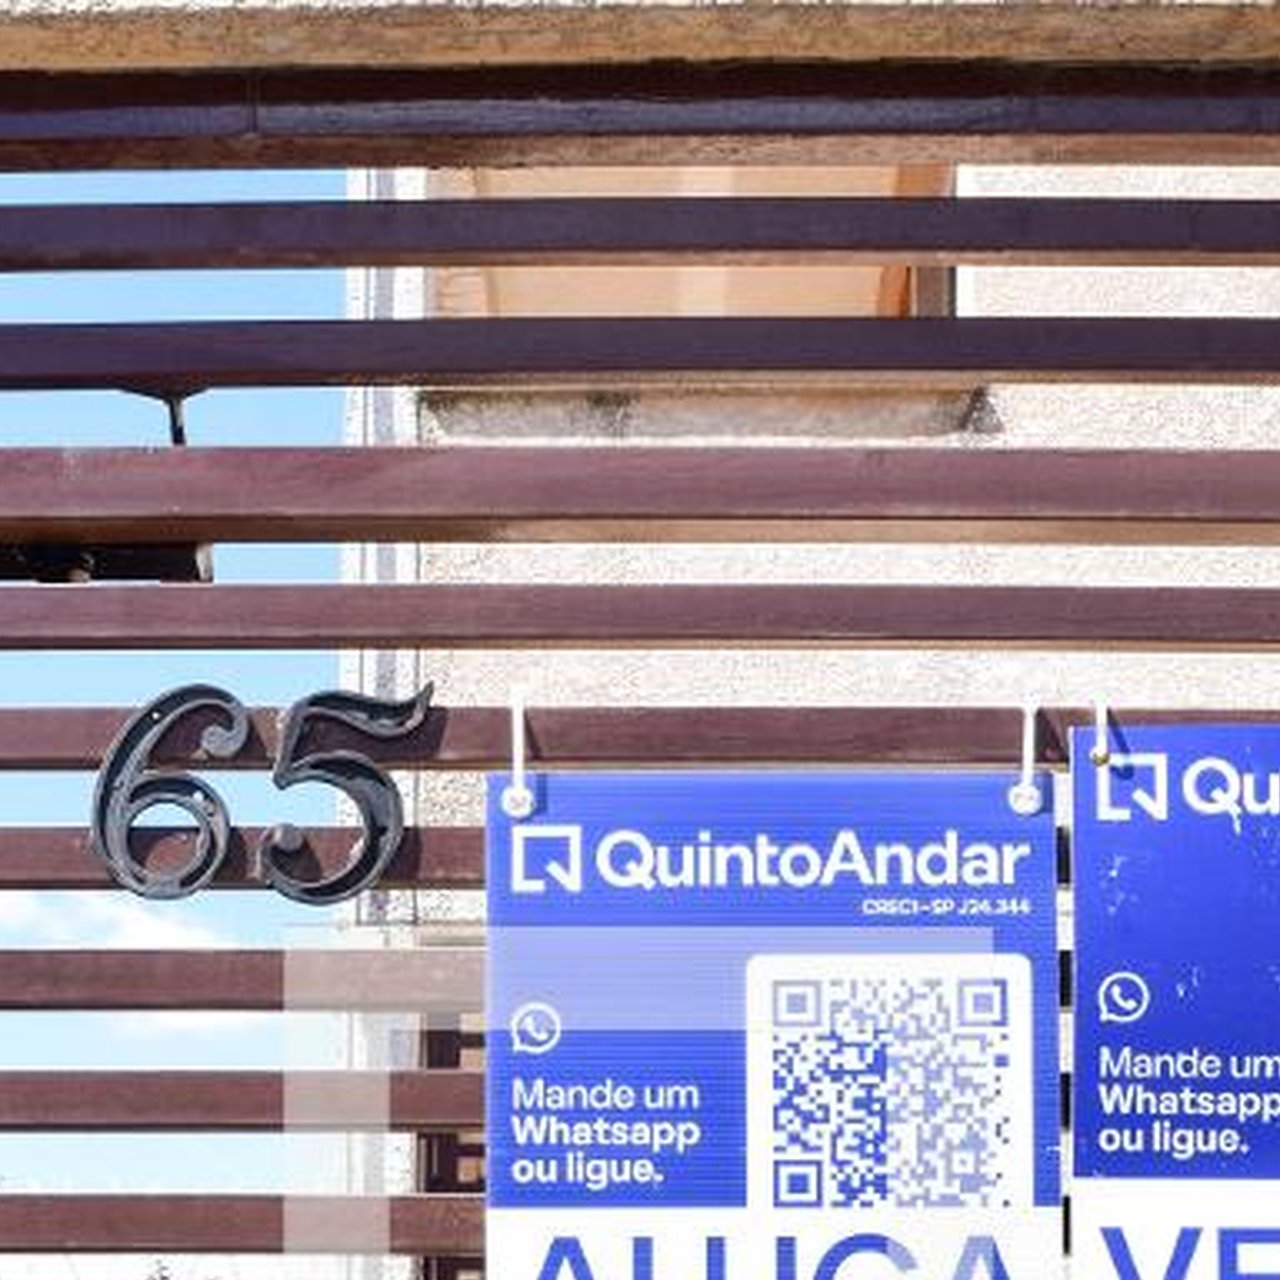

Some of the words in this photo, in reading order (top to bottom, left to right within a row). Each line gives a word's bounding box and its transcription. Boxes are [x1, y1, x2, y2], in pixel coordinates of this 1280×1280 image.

[92, 681, 434, 906] 65
[595, 830, 1031, 890] QuintoAndar
[1099, 1046, 1220, 1079] Mande
[511, 1078, 635, 1110] Mande
[644, 1086, 700, 1110] um
[511, 1116, 701, 1152] Whatsapp
[1098, 1127, 1145, 1152] ou
[1152, 1120, 1249, 1160] ligue.
[511, 1157, 559, 1182] ou
[566, 1151, 664, 1190] ligue.
